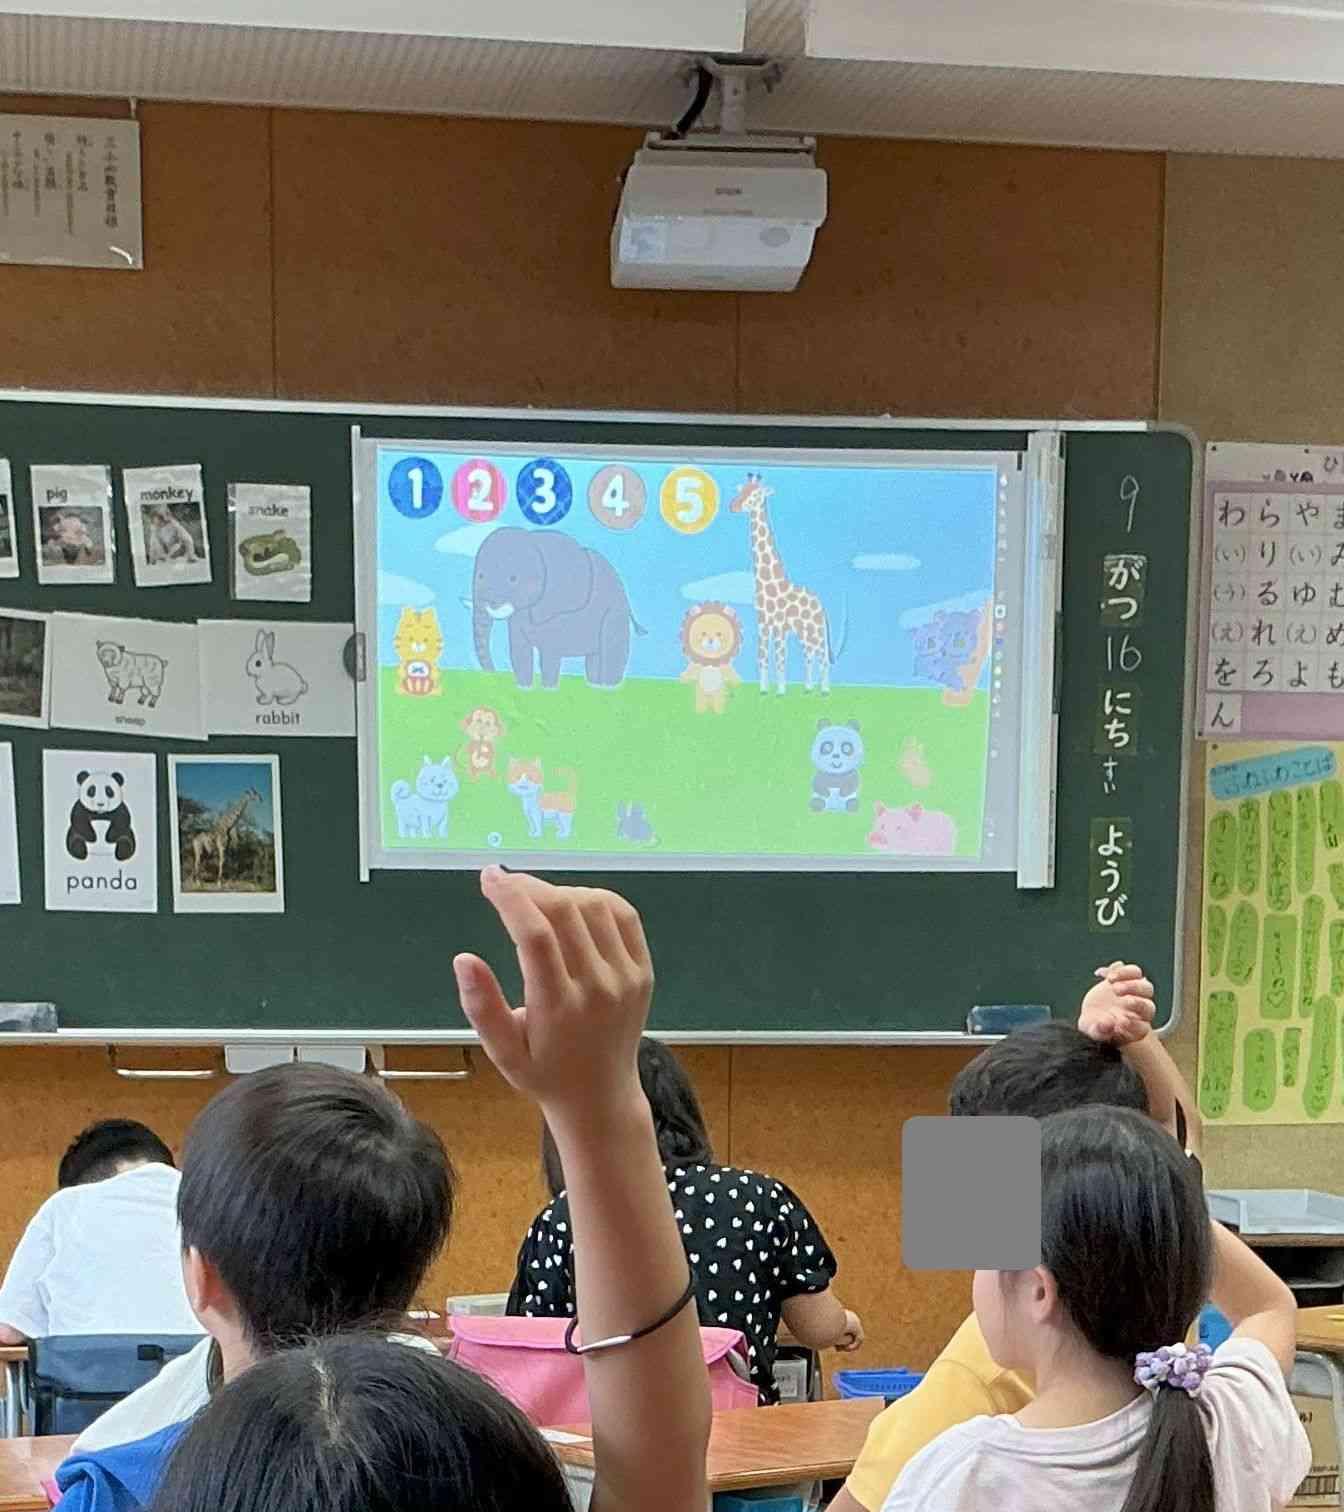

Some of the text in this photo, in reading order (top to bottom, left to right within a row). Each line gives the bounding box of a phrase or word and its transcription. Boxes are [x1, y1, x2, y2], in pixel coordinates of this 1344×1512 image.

[46, 487, 68, 504] pig
[140, 487, 193, 501] monkey
[408, 467, 705, 523] 1 2 3 4 5
[1120, 474, 1140, 533] 9
[1218, 499, 1246, 527] わ
[1295, 501, 1320, 527] や
[1107, 558, 1144, 620] がつ
[1251, 498, 1281, 687] ら り る れ ろ
[1292, 581, 1317, 606] ゆ
[1106, 634, 1142, 672] 16
[1213, 657, 1237, 687] を
[1288, 660, 1308, 688] よ
[1327, 660, 1344, 690] も
[256, 712, 301, 725] rabbit
[1104, 689, 1132, 748] にち
[1210, 702, 1235, 729] ん
[67, 869, 137, 893] panda
[1095, 824, 1129, 927] ようび
